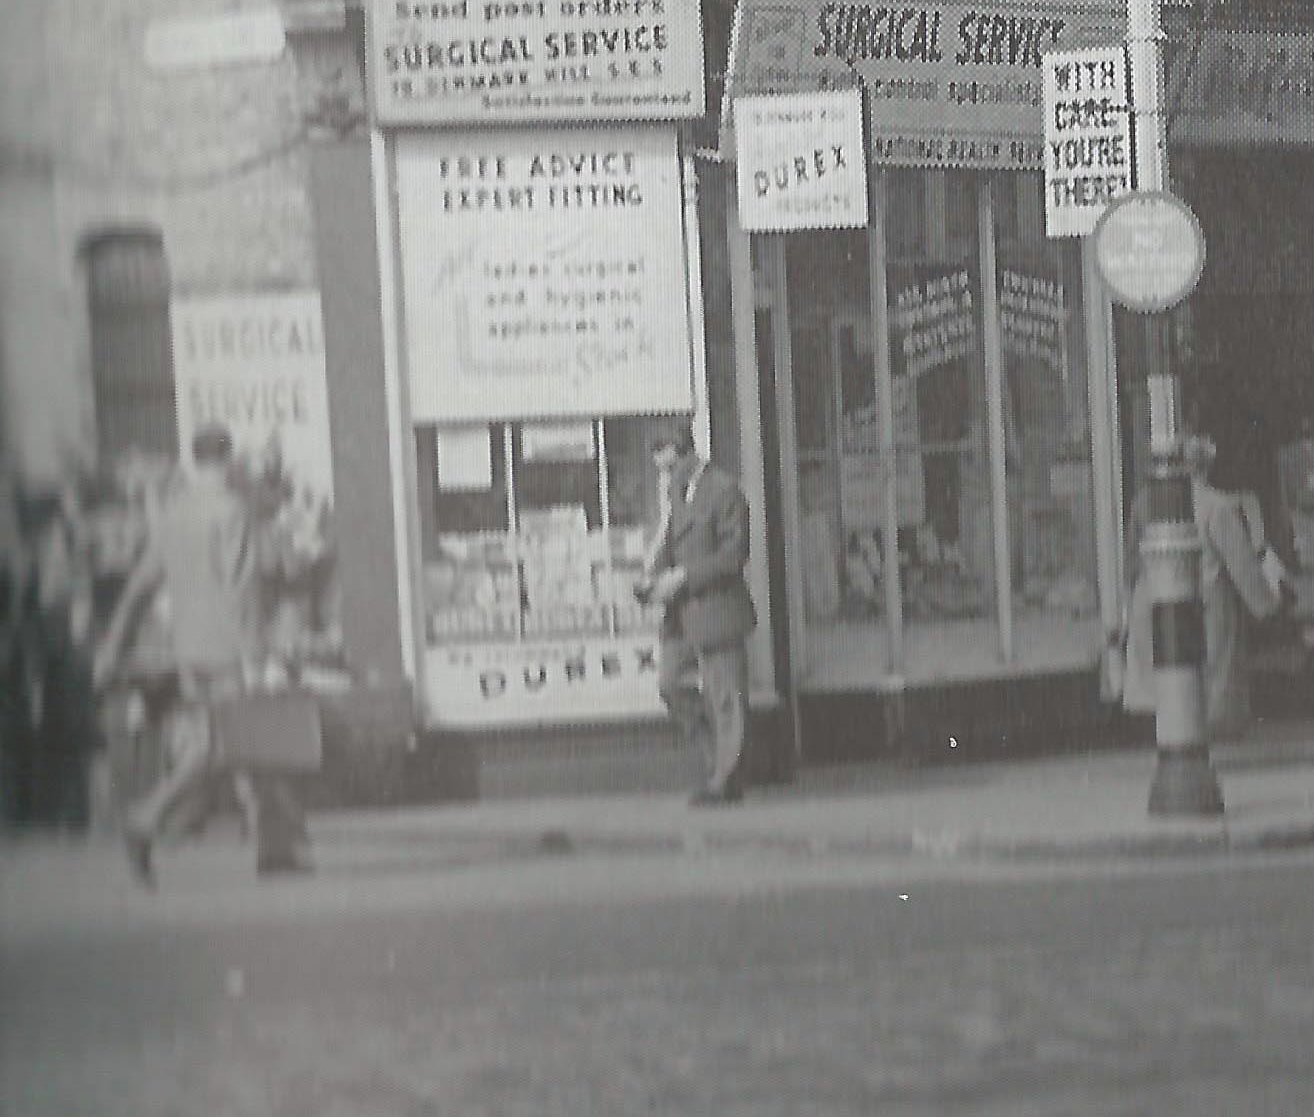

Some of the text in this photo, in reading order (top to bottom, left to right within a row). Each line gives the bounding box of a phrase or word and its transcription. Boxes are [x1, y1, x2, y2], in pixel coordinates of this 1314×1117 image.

[484, 0, 547, 23] post
[384, 24, 668, 72] SURGICAL SERVICE
[813, 1, 942, 62] SURGICAL
[544, 61, 590, 83] HILL
[1055, 61, 1116, 92] WITH
[440, 151, 636, 179] FREE ADVICE
[753, 144, 849, 200] DUREX
[443, 183, 644, 213] EXPERT FITTING
[184, 315, 317, 361] SURGICAL
[477, 647, 657, 704] DUREX
